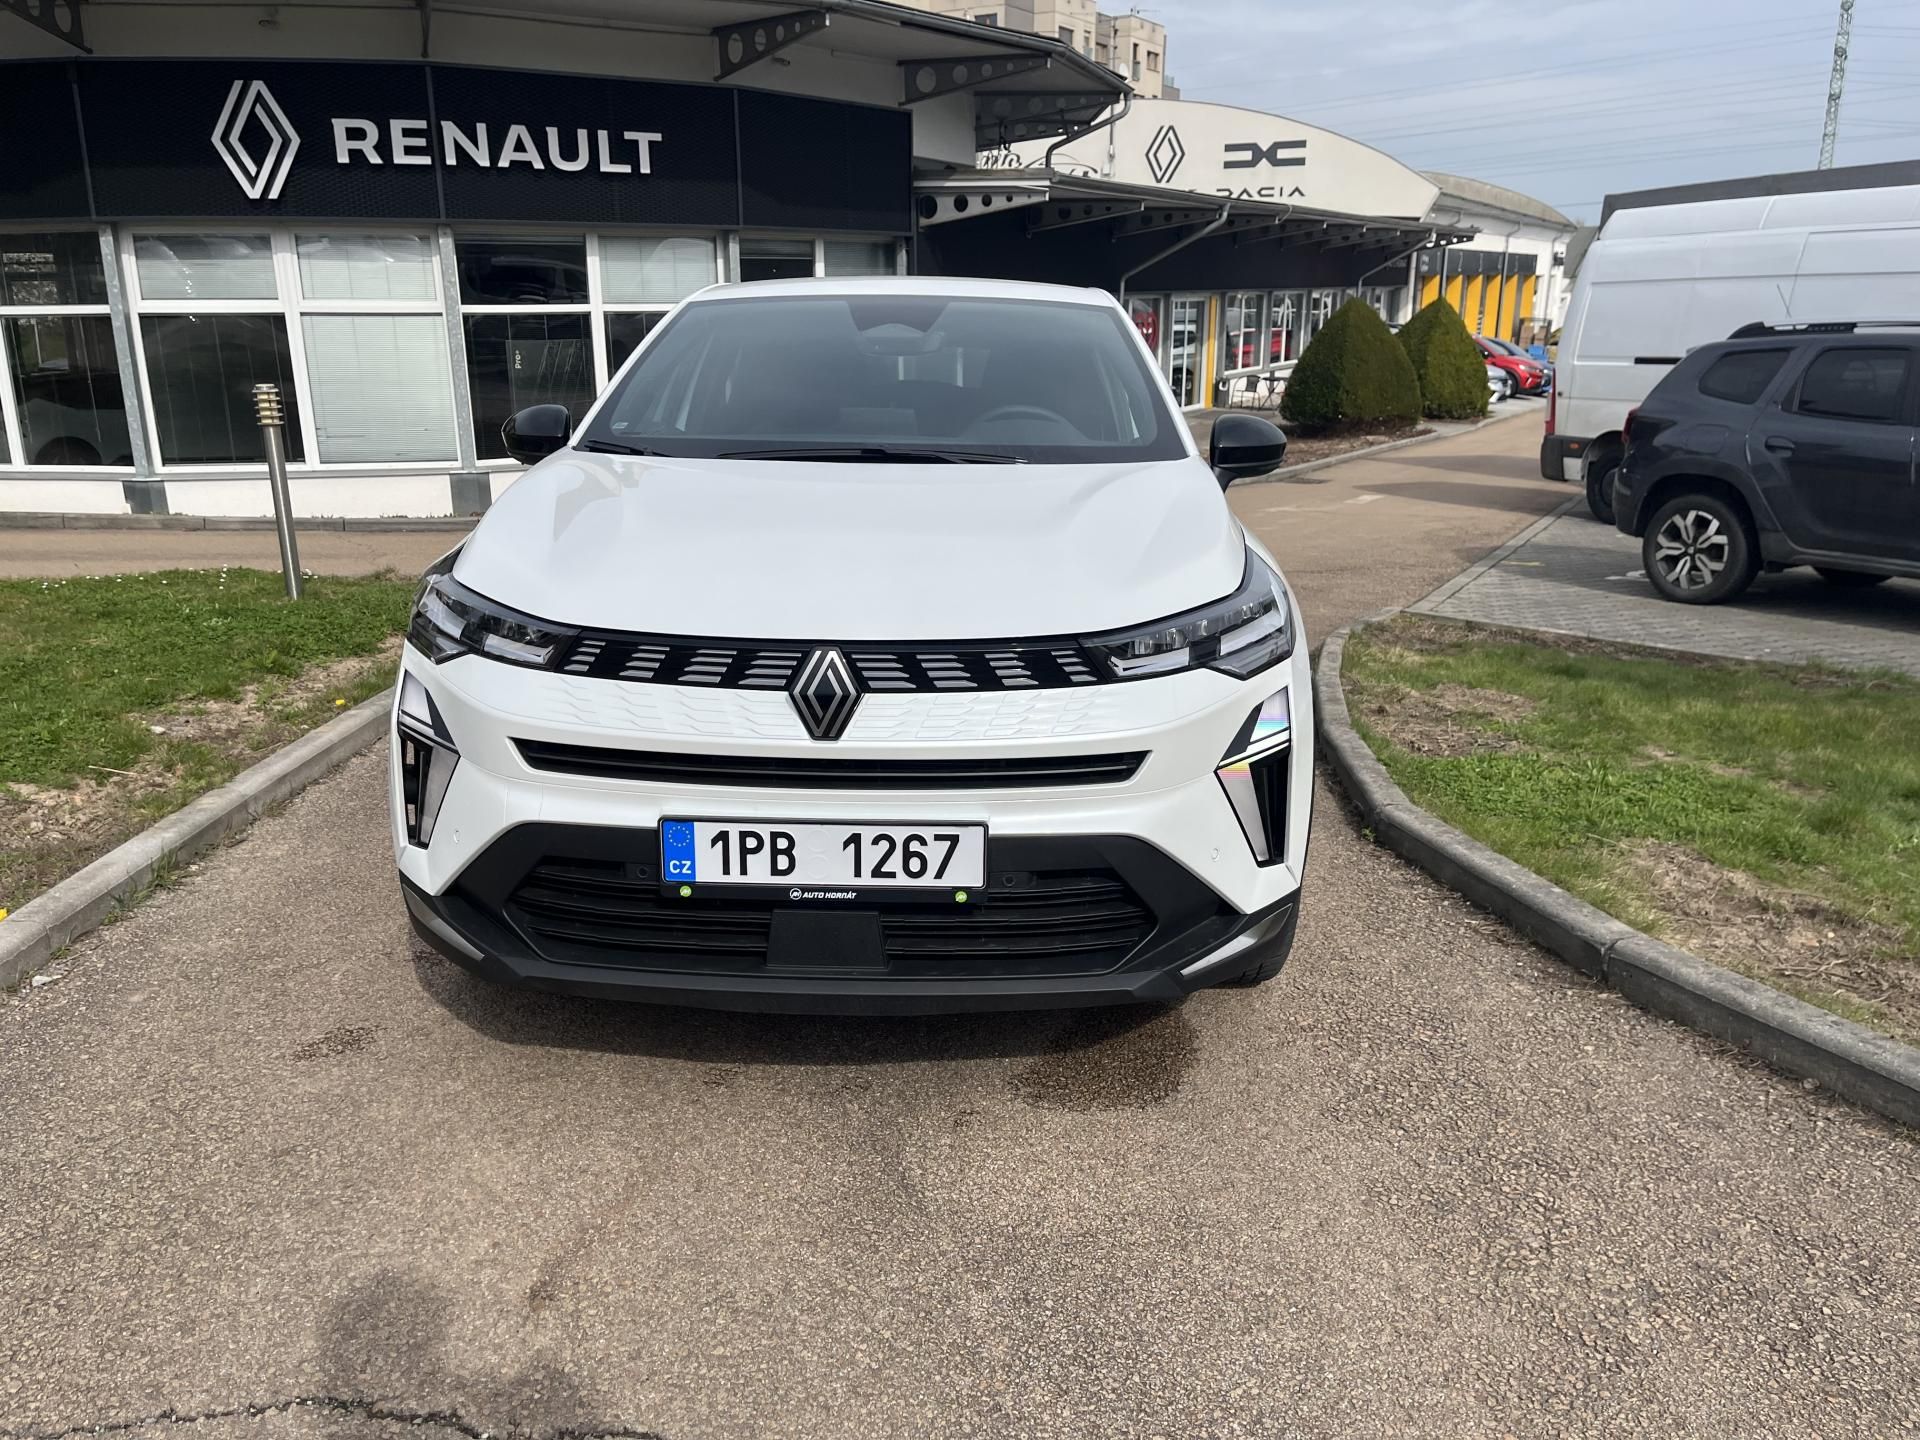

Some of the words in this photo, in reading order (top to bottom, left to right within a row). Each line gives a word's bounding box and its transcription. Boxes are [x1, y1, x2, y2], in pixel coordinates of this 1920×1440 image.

[331, 118, 662, 174] RENAULT
[669, 860, 692, 874] CZ
[710, 830, 797, 877] 1PB
[842, 833, 960, 880] 1267
[802, 891, 825, 899] AUTO
